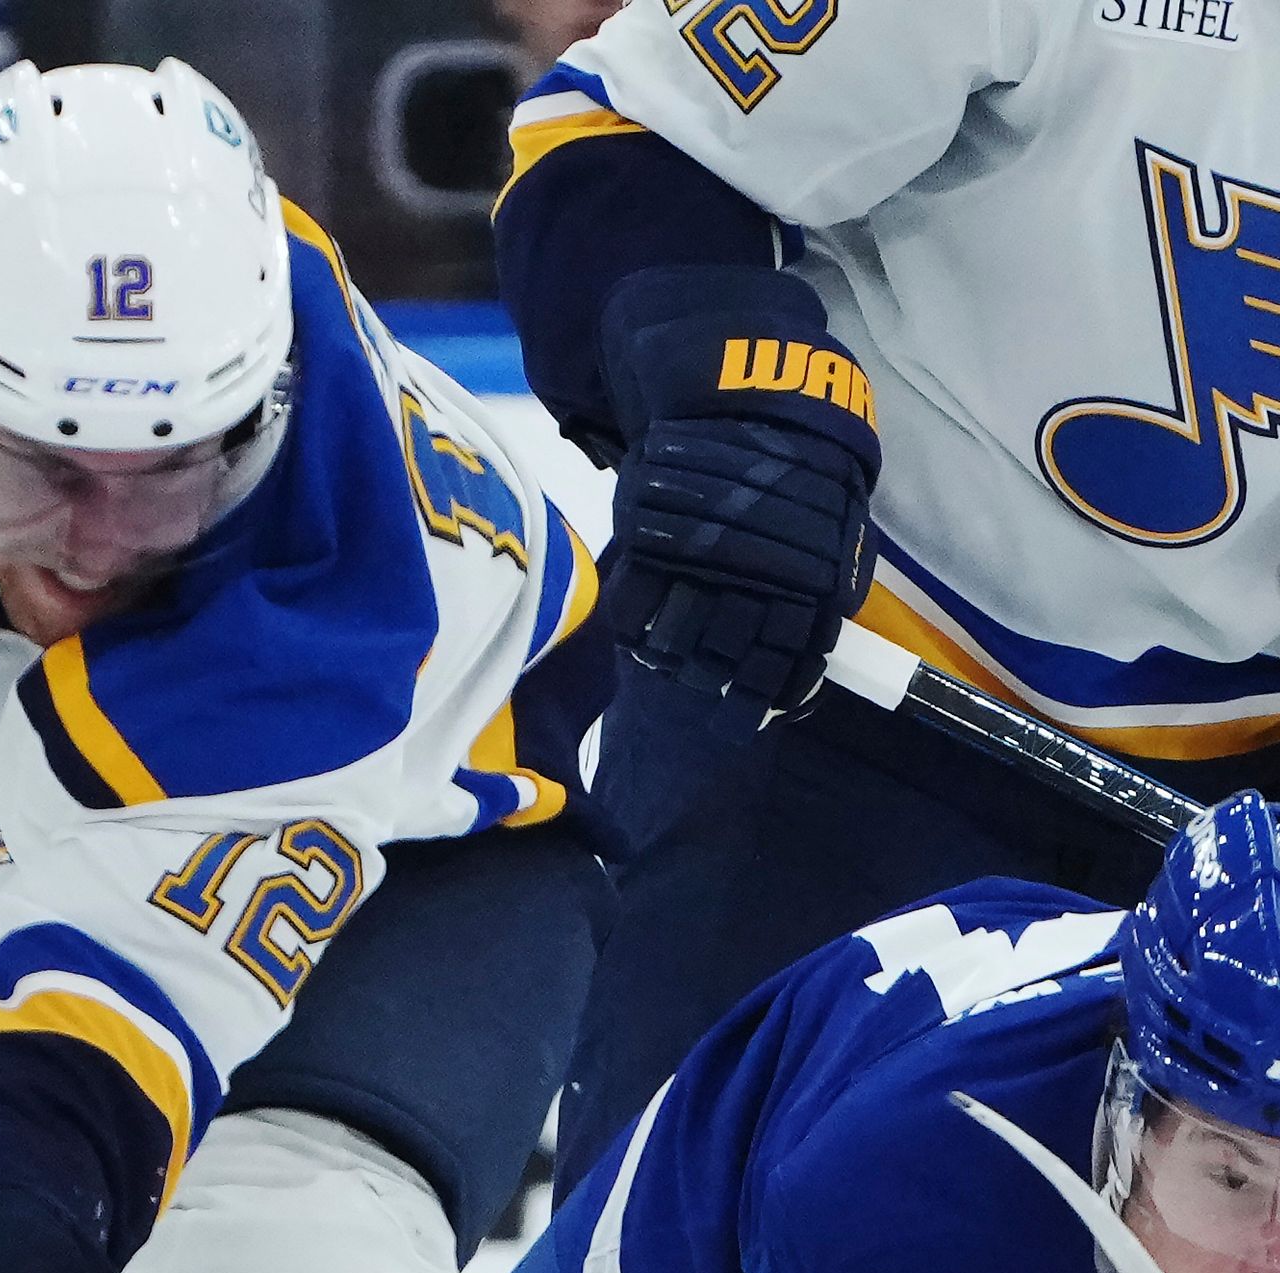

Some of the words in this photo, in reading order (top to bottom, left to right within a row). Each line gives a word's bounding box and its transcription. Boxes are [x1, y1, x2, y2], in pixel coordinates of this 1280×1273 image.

[663, 0, 838, 115] 2
[86, 254, 153, 321] 12
[65, 376, 180, 396] CCM
[147, 817, 366, 1011] 12
